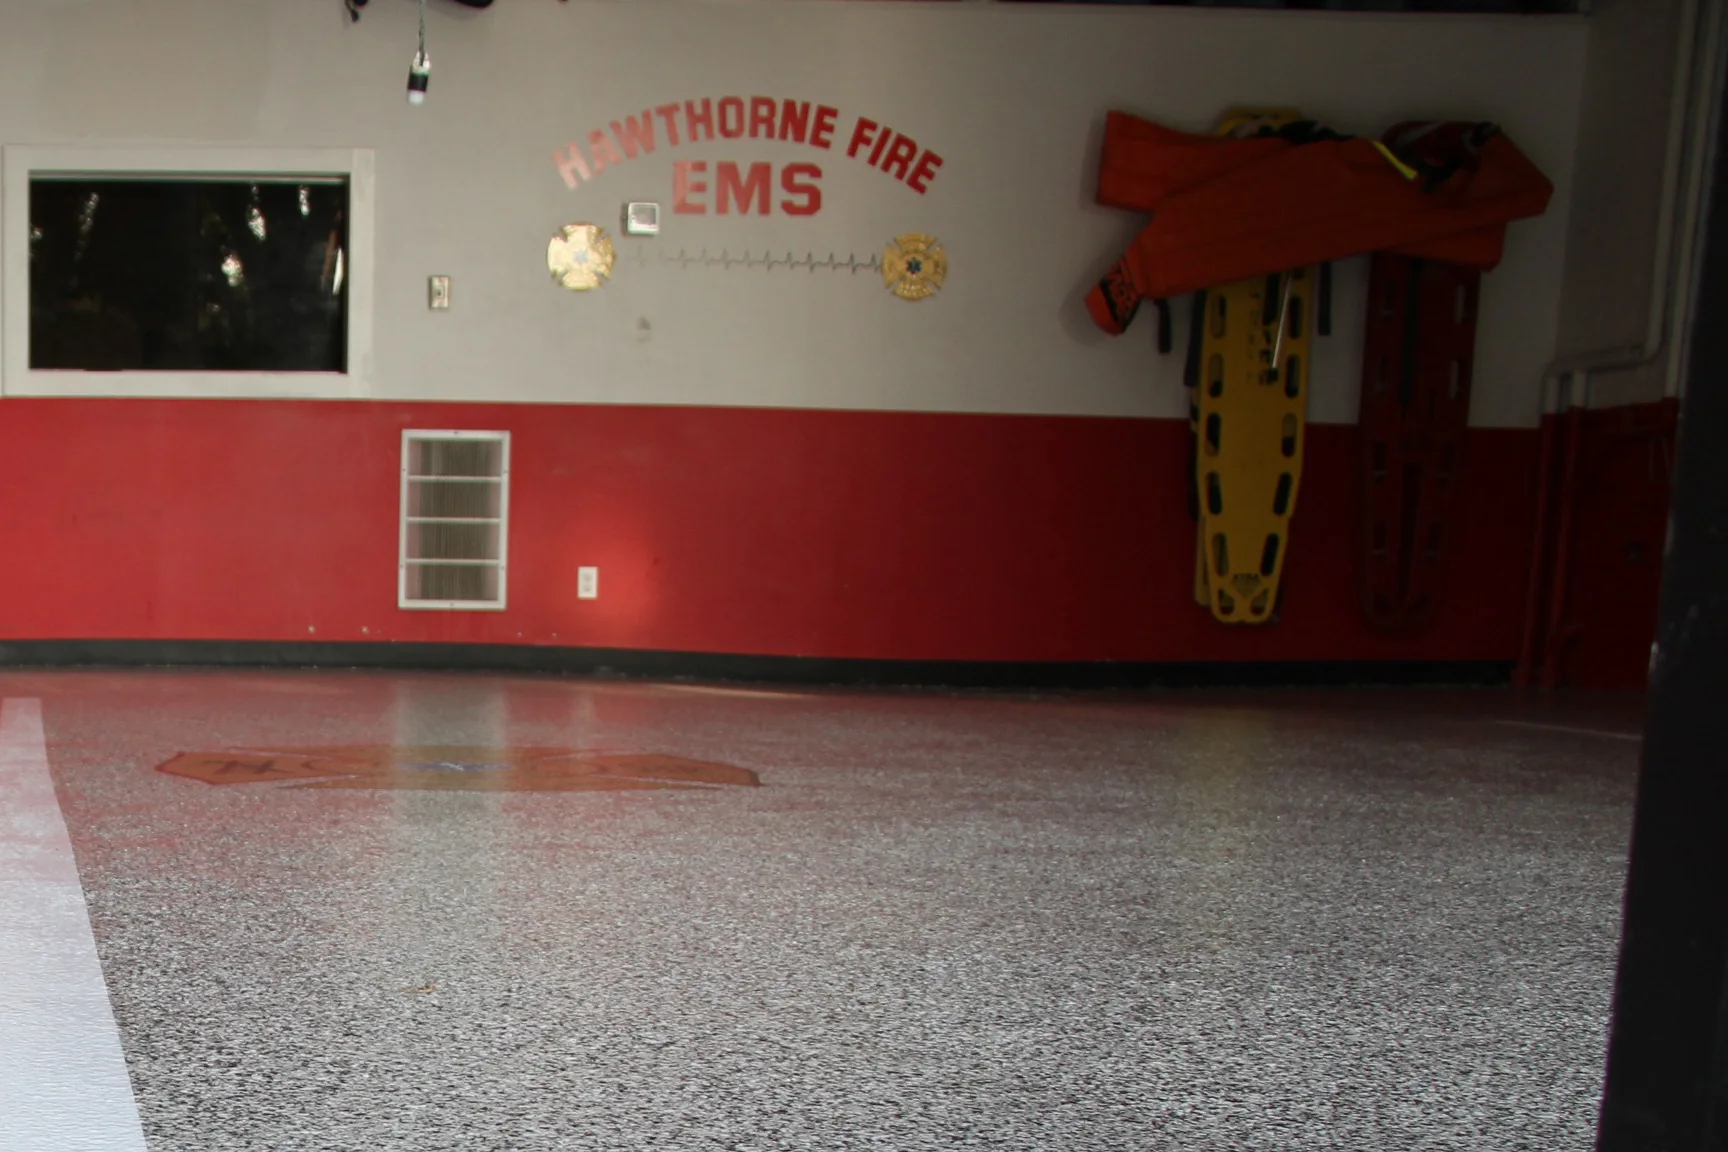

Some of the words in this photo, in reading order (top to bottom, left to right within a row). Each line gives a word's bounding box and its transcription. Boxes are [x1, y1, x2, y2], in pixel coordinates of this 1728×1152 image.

[553, 96, 839, 189] HAWTHORNE
[846, 116, 944, 195] FIRE
[673, 160, 823, 217] EMS
